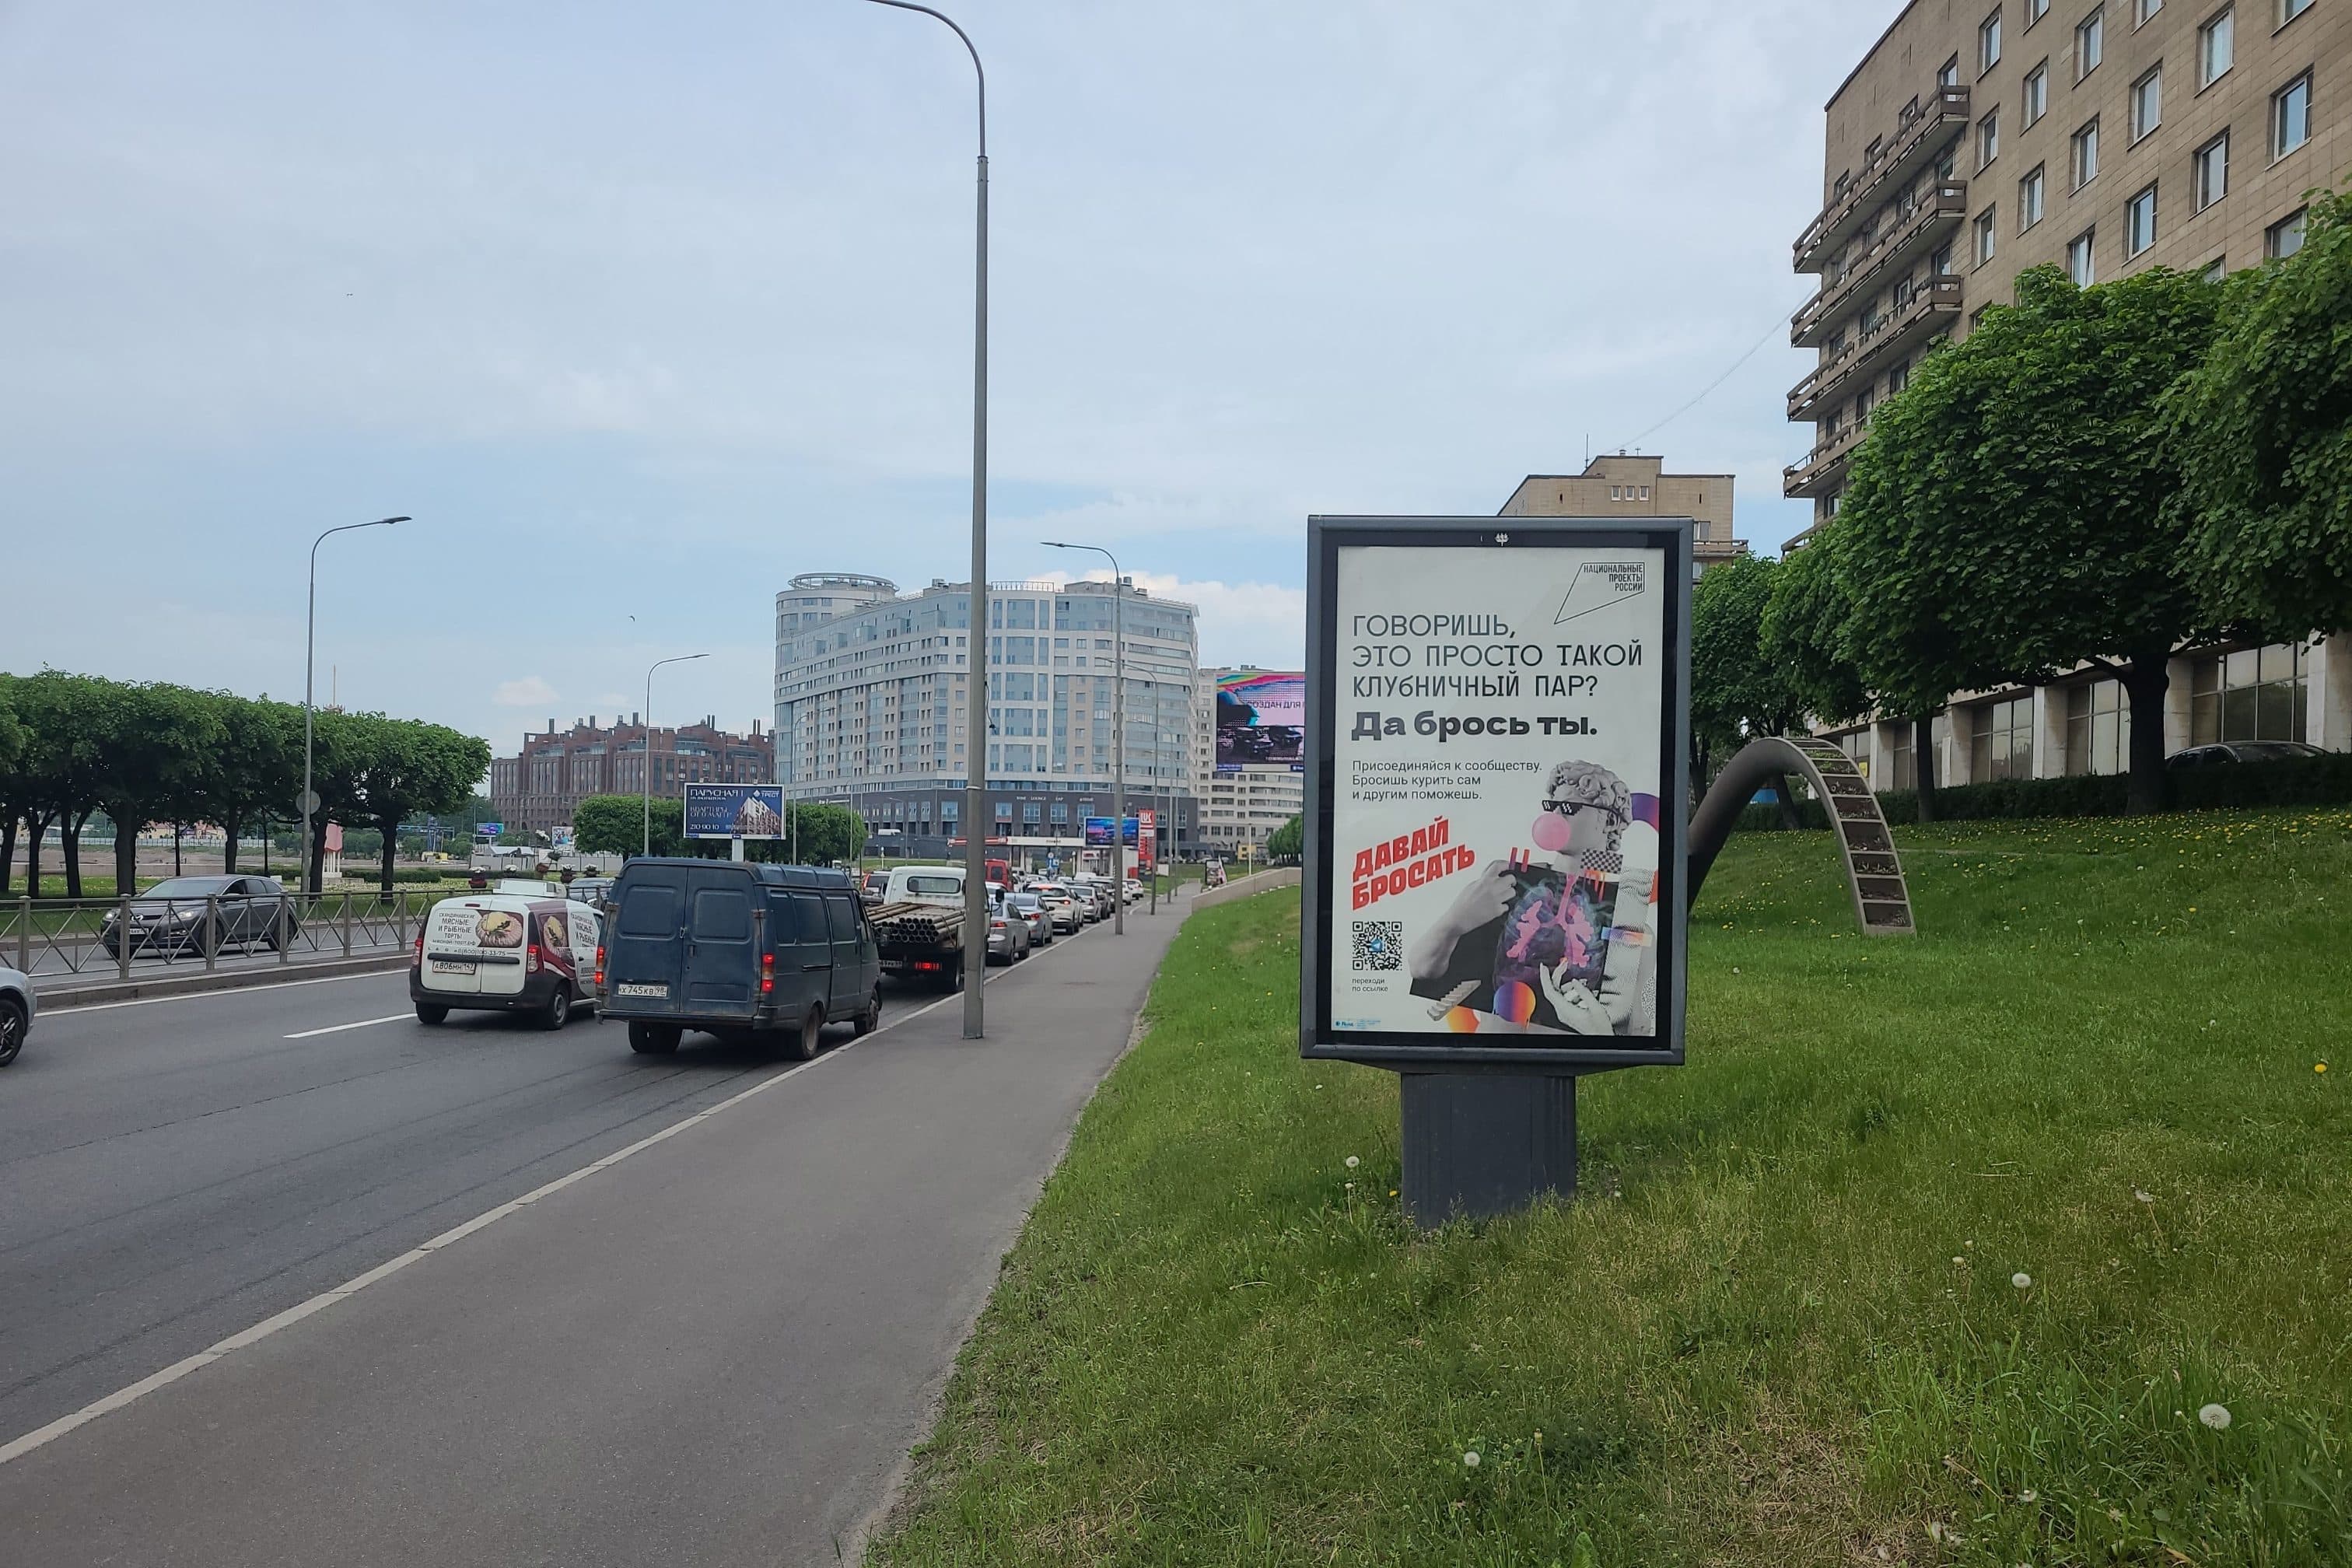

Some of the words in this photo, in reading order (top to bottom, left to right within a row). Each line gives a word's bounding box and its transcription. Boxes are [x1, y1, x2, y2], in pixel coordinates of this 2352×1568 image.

[1584, 564, 1643, 574] НАЦИОНАЛЬНЫЕ
[1608, 573, 1643, 583] ПРОЕКТЫ
[1615, 583, 1643, 592] РОССИИ
[1353, 614, 1516, 639] ГОВОРИШЬ,
[1353, 645, 1411, 667] ЭТО
[1426, 644, 1543, 667] ПРОСТО
[1556, 639, 1642, 667] ТАКОЙ
[1535, 675, 1598, 698] ПАР?
[1351, 712, 1406, 741] Да
[1414, 710, 1531, 742] брось
[1536, 716, 1598, 736] ты.
[1353, 759, 1451, 773] Присоединяйся
[1454, 763, 1461, 772] к
[1465, 761, 1542, 773] сообществу.
[1353, 775, 1408, 788] Бросишь
[1412, 776, 1454, 788] курить
[1457, 776, 1481, 786] сам
[1353, 791, 1360, 800] и
[1363, 791, 1408, 802] другим
[1412, 791, 1482, 800] поможешь.
[1353, 814, 1450, 883] ДАВАЙ
[1353, 844, 1476, 911] БРОСАТЬ
